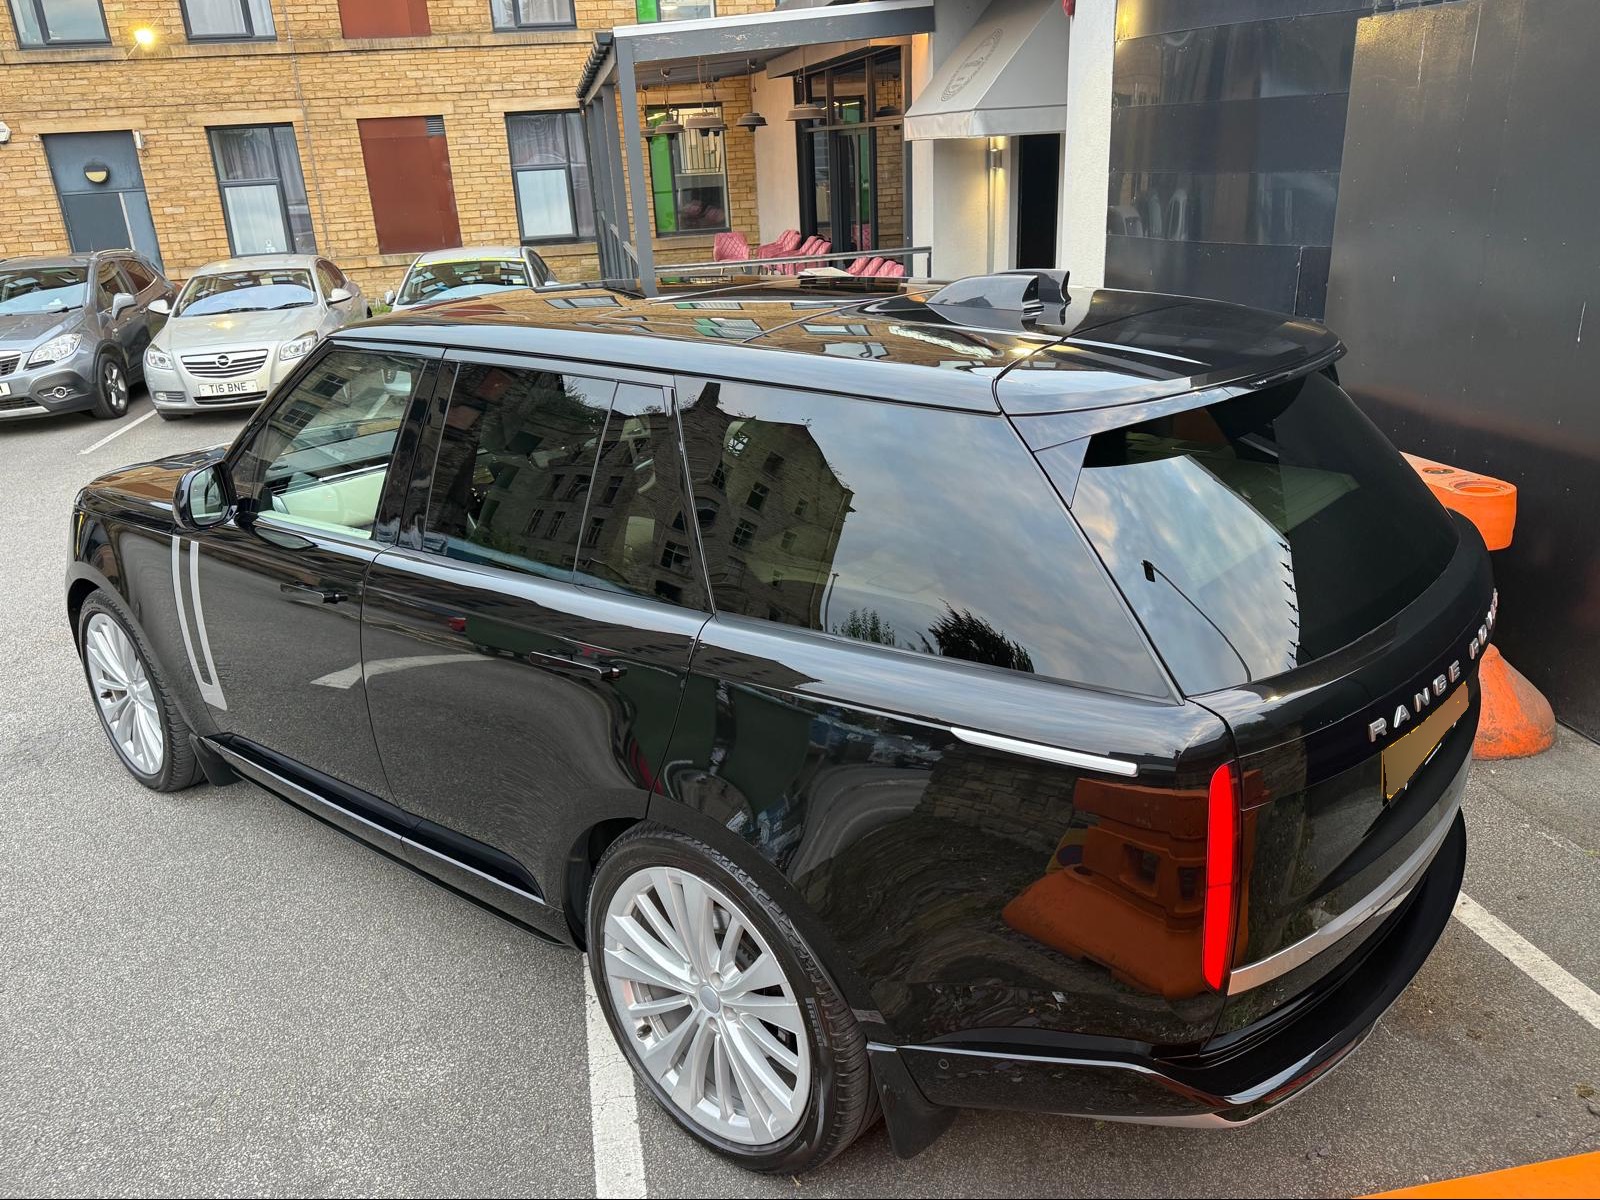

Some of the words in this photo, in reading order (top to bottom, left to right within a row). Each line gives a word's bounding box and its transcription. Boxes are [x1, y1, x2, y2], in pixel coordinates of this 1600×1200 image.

[209, 384, 225, 394] T16
[227, 382, 248, 393] BNE
[1368, 659, 1461, 743] RANGE
[1469, 587, 1499, 660] ROV
